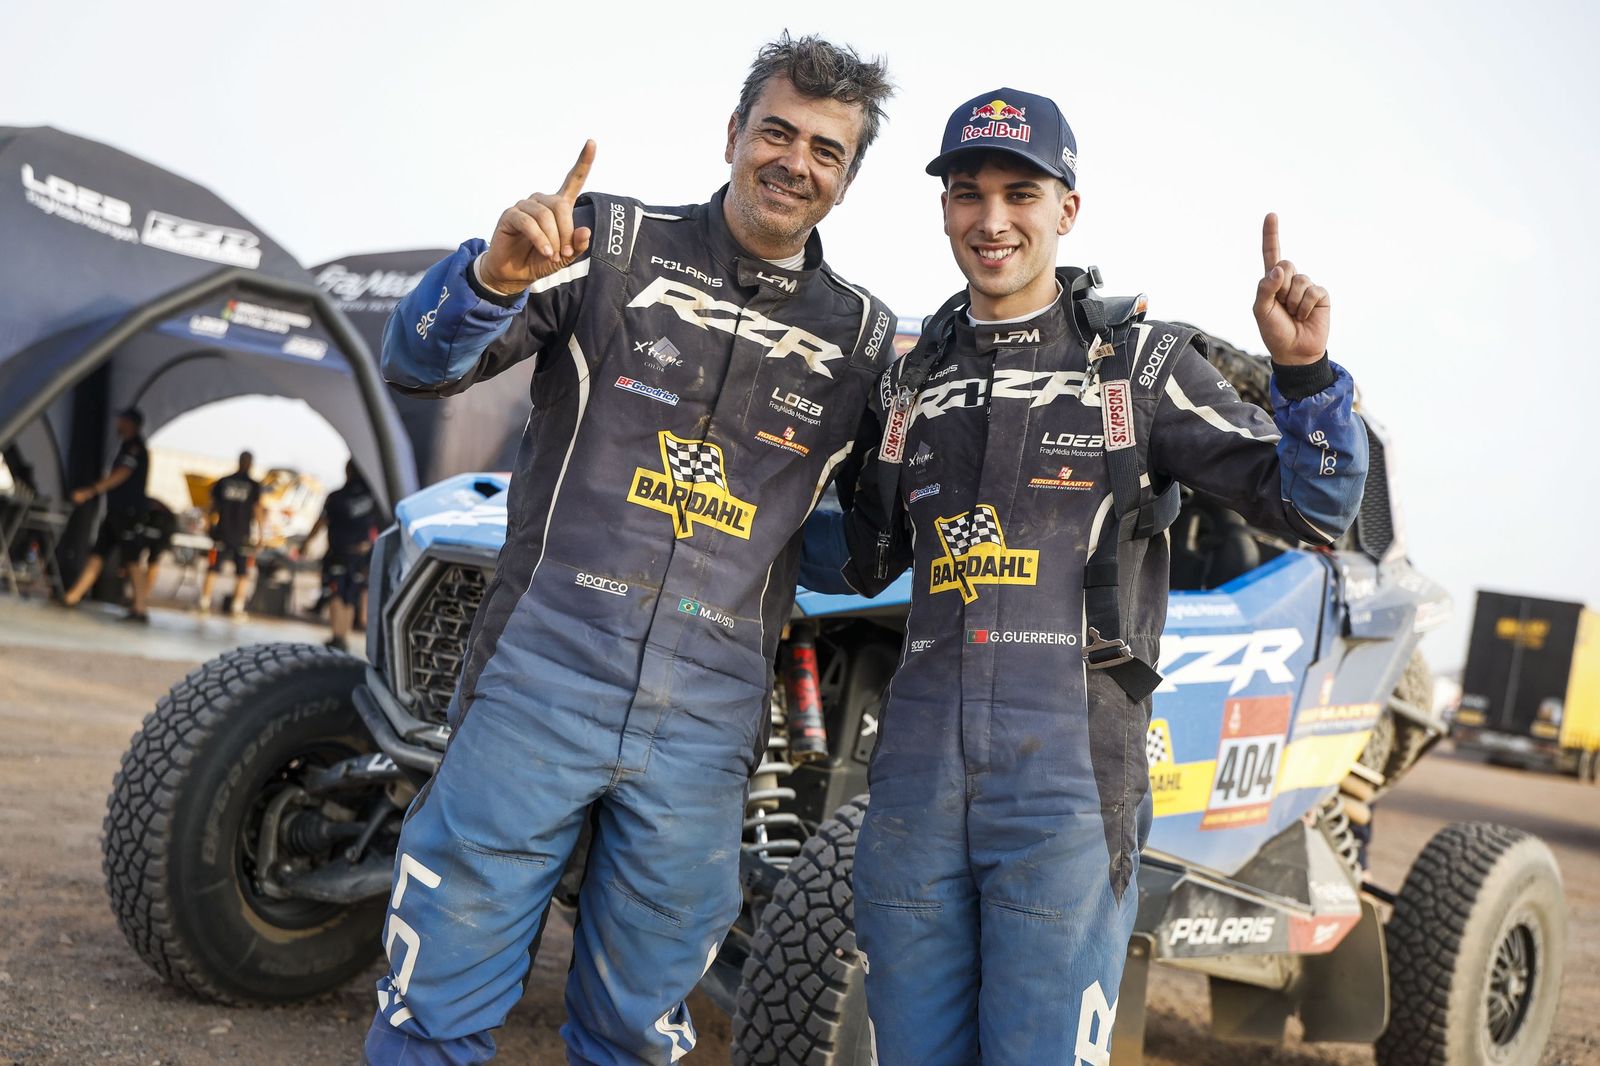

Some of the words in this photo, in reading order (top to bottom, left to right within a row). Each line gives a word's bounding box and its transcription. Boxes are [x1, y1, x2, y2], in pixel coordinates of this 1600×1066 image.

[961, 121, 994, 142] Red
[995, 122, 1031, 142] Bull
[607, 202, 626, 256] sparco
[650, 255, 723, 288] POLARIS
[756, 271, 798, 293] LFM
[626, 275, 844, 380] RZR
[864, 311, 890, 361] sparco
[993, 328, 1041, 344] LFM
[928, 364, 959, 381] LARIS
[1138, 333, 1179, 390] sparco
[617, 377, 679, 402] BFGoodrich
[771, 386, 824, 416] LOEB
[757, 430, 783, 445] ROGER
[885, 409, 906, 458] SIMPSO
[1041, 432, 1105, 448] LOEB
[1070, 449, 1104, 458] Motorsport
[1030, 478, 1061, 486] ROGER
[1061, 479, 1094, 487] MARTIN
[634, 476, 746, 533] BARDAHL
[575, 571, 628, 596] sparco
[932, 553, 1032, 598] BARDAHL
[989, 630, 1077, 647] G.GUERREIRO
[1215, 741, 1277, 801] 404
[1168, 916, 1276, 946] POLARIS
